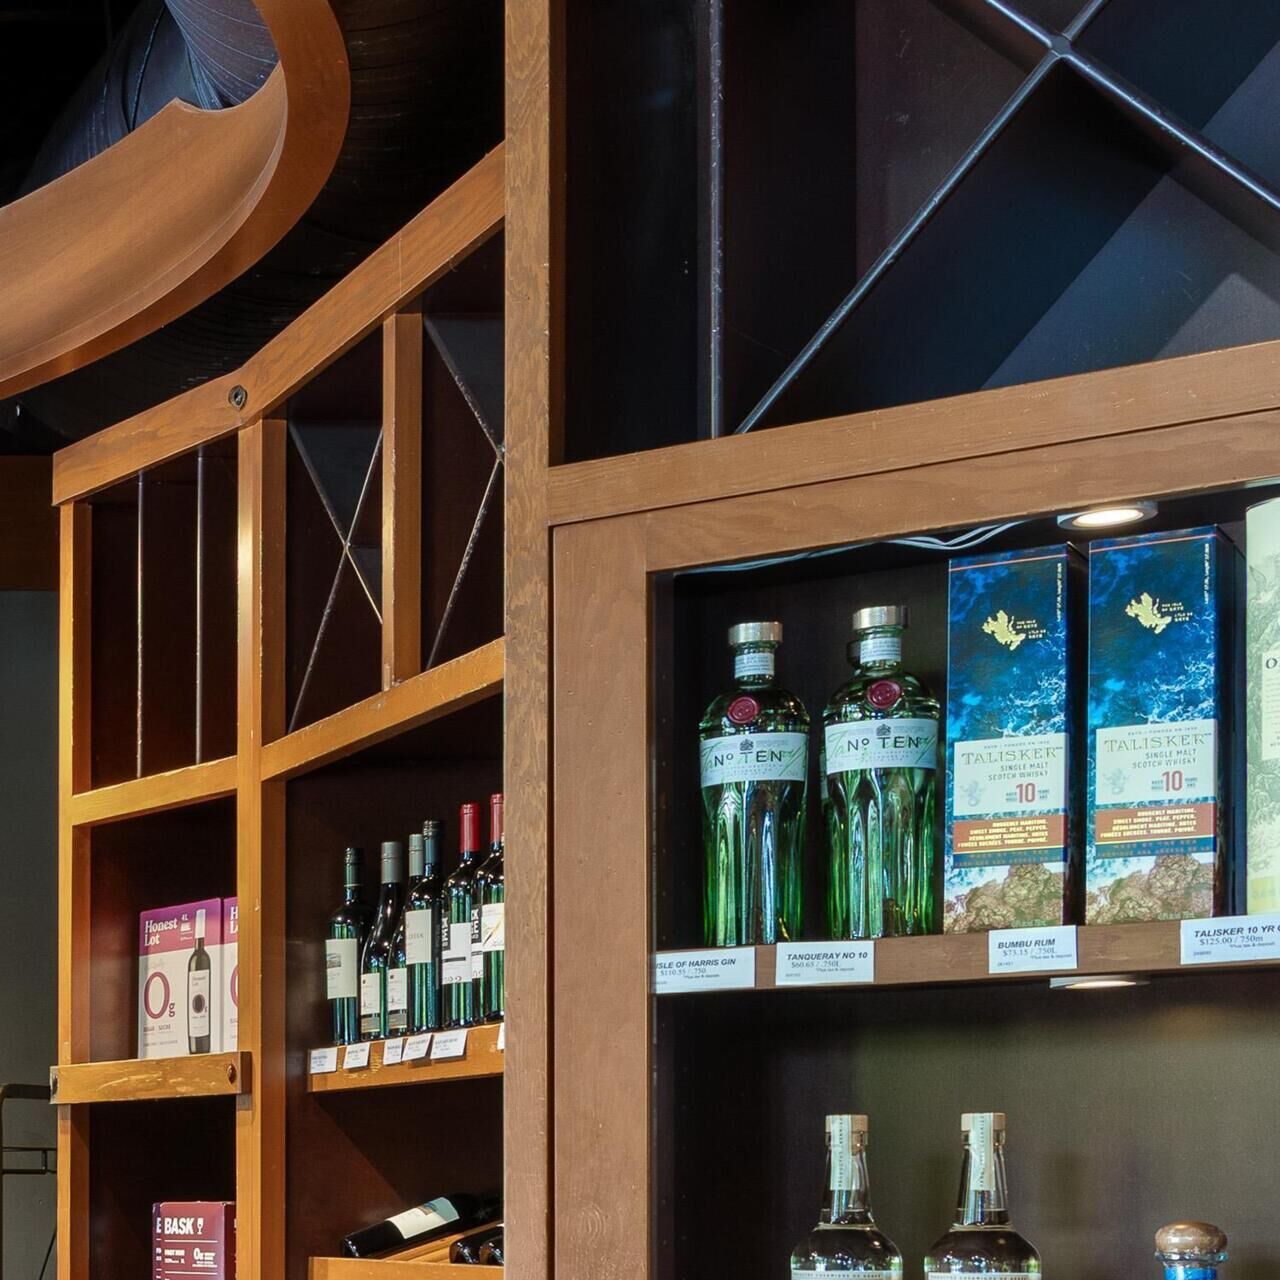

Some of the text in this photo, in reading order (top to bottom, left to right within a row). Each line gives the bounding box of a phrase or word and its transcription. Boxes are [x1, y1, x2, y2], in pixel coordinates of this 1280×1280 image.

[879, 736, 919, 749] TEN
[1104, 733, 1205, 752] TALISKER
[740, 750, 782, 764] TEN
[961, 747, 1057, 765] TALISKER
[1145, 748, 1196, 759] SINGLE MALT
[1001, 762, 1048, 772] SINGLE MALT
[1132, 758, 1196, 769] SCOTCH WHISKY
[988, 771, 1048, 781] SCOTCH WHISKY
[1162, 770, 1183, 792] 10
[1016, 783, 1036, 803] 10
[144, 917, 178, 934] Honest
[1194, 924, 1275, 938] TALISKER 10 YR
[144, 933, 160, 947] Lot
[997, 938, 1056, 949] BUMBU RUM
[1199, 936, 1233, 946] $125.00
[787, 951, 869, 961] TANQUERAY NO 10
[675, 960, 688, 969] OF
[688, 958, 719, 968] HARRIS
[720, 957, 737, 966] GIN
[164, 1217, 195, 1235] BASK
